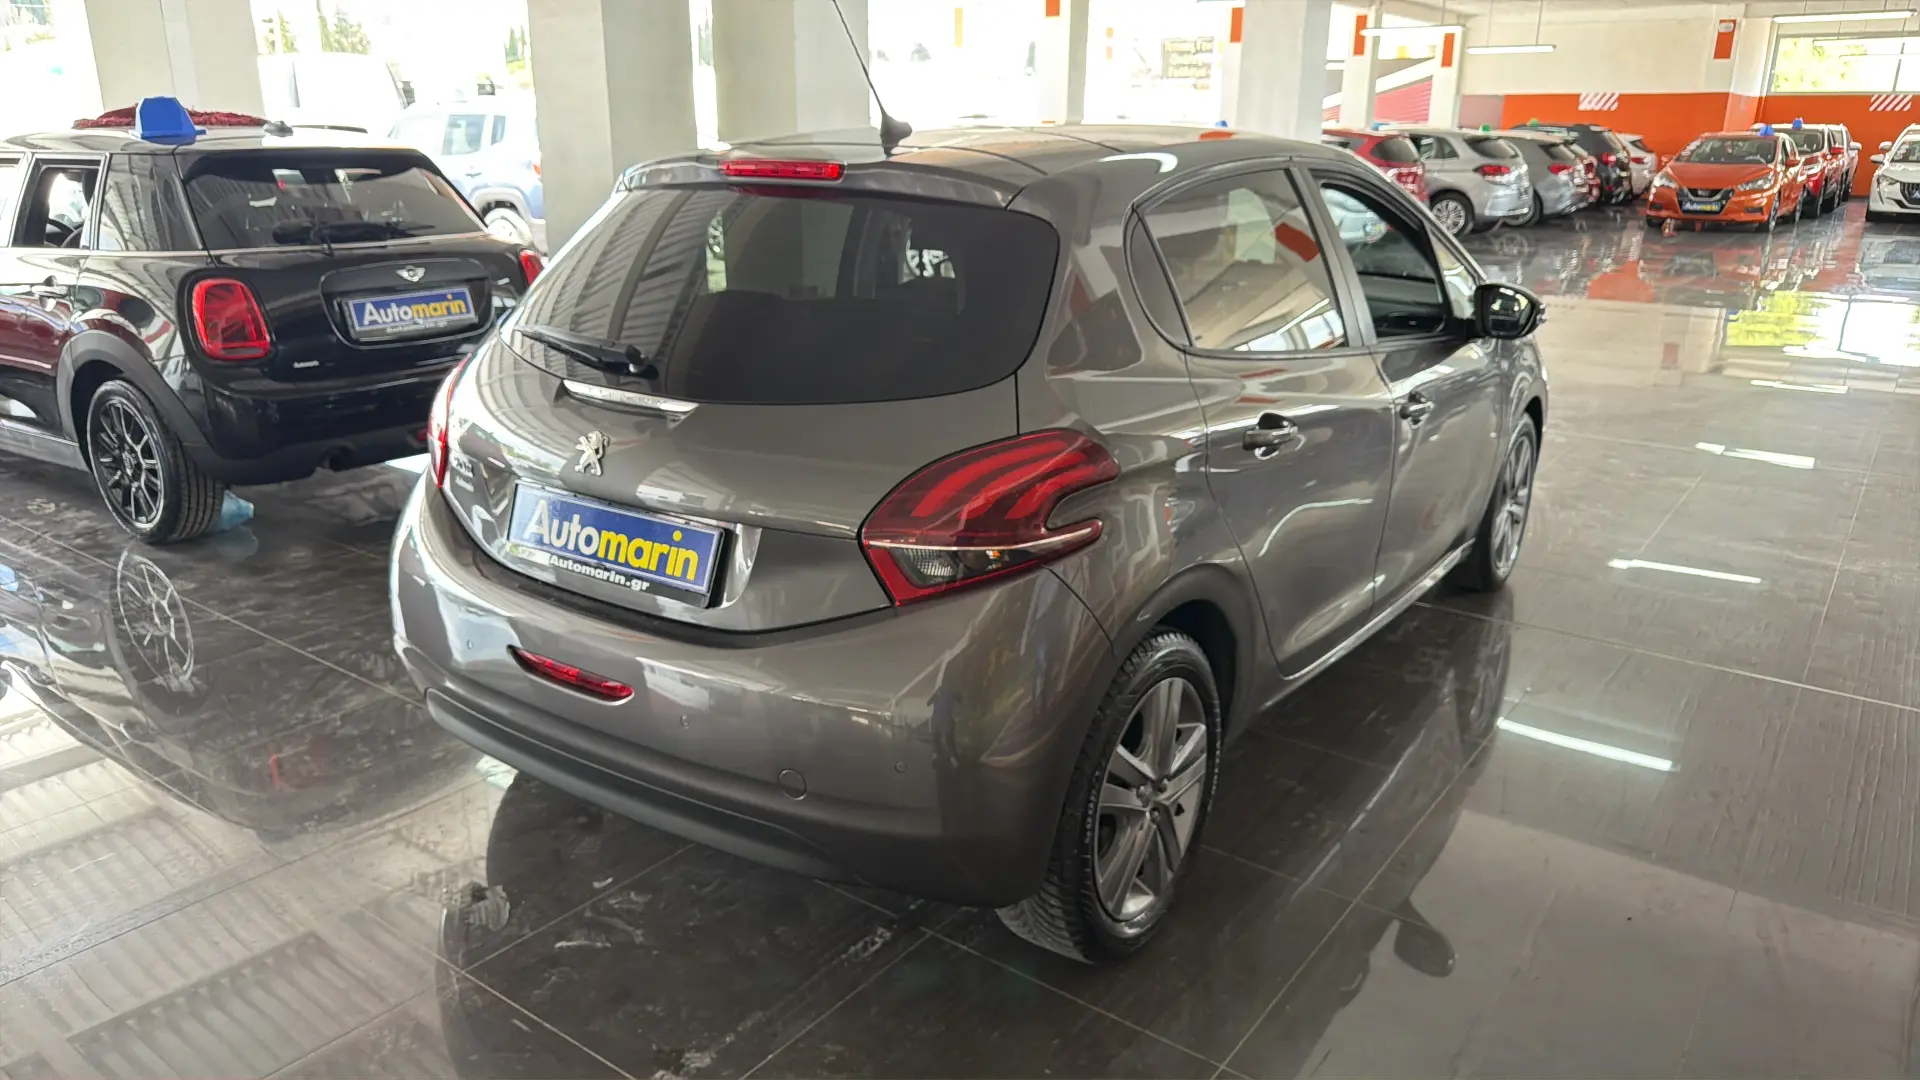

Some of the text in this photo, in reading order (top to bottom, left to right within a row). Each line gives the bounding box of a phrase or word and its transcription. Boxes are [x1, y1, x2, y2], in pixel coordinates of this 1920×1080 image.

[363, 293, 467, 326] Automarin
[523, 499, 699, 581] Automarin
[549, 555, 650, 591] Automarin.gr
